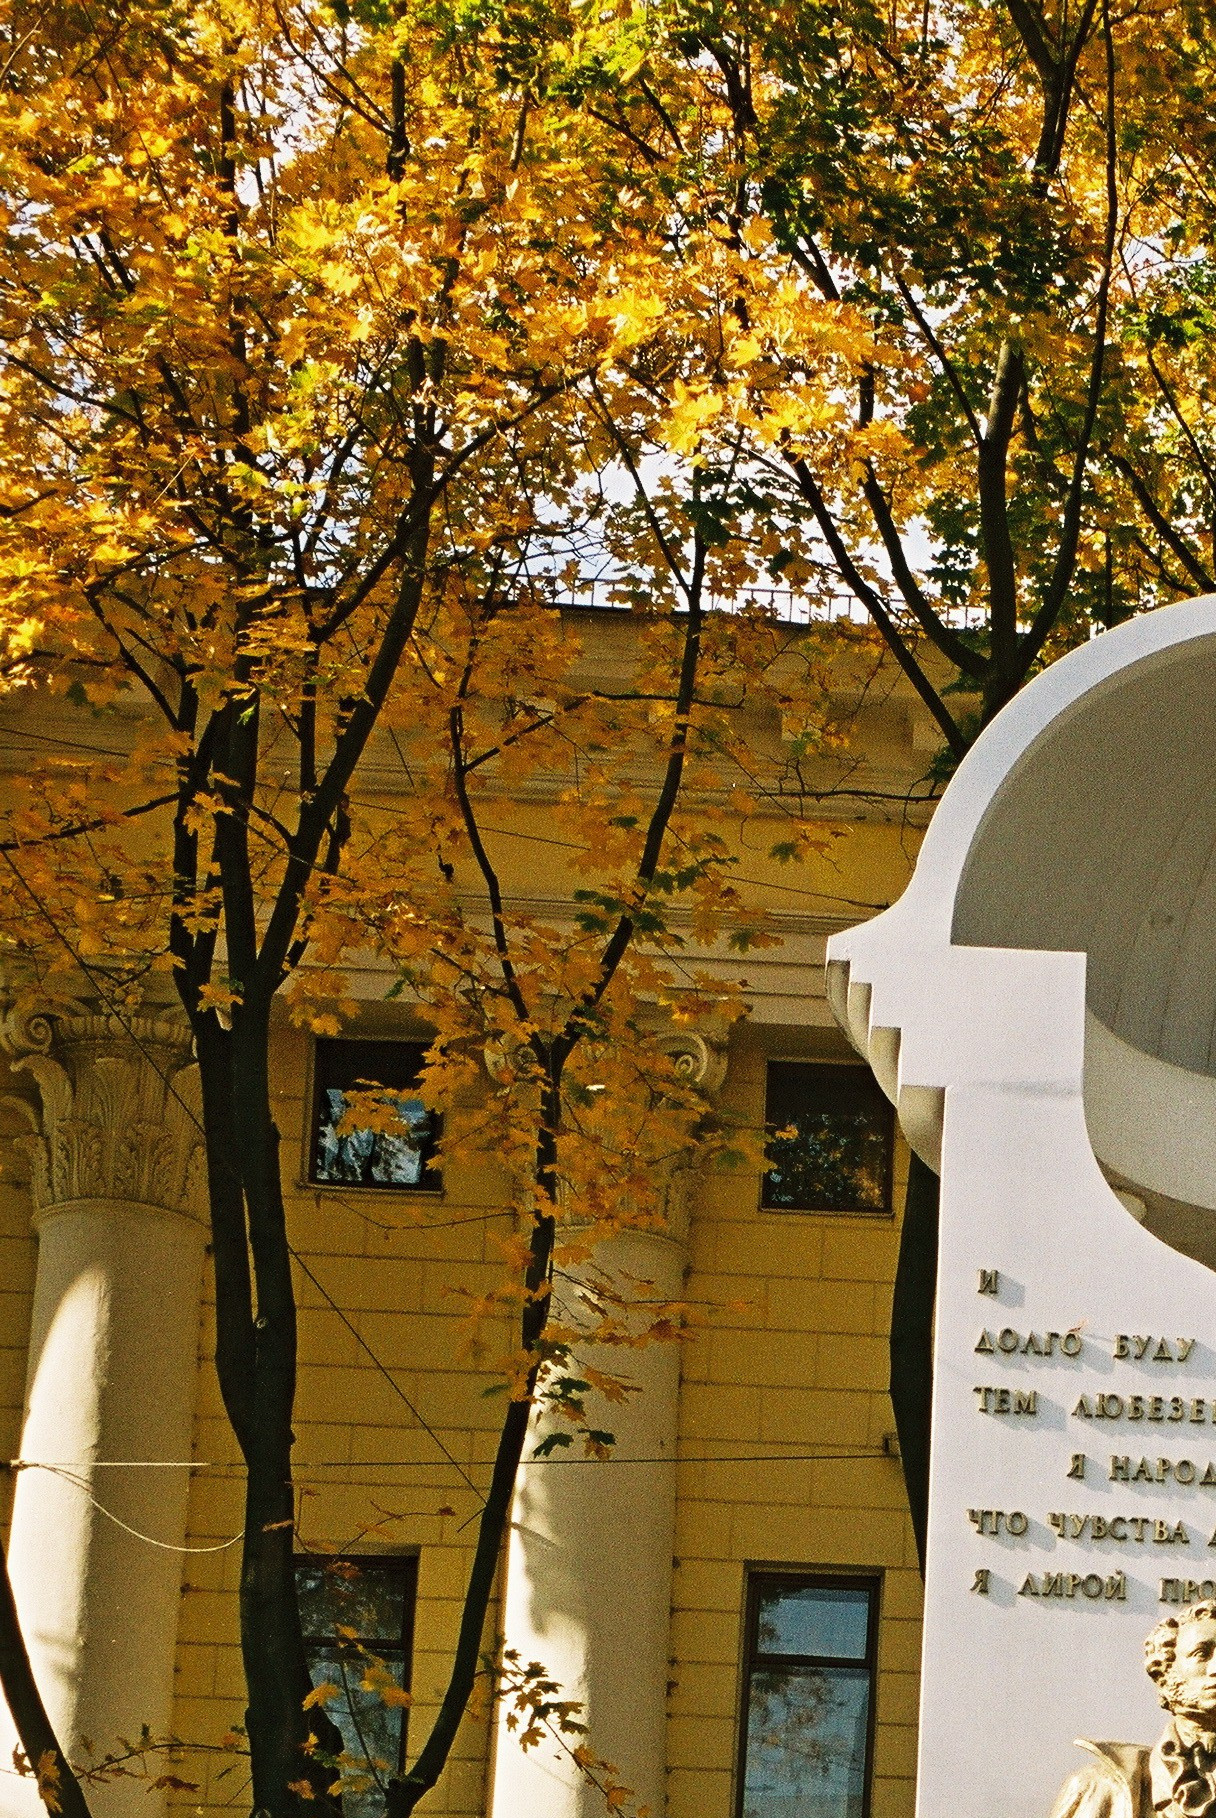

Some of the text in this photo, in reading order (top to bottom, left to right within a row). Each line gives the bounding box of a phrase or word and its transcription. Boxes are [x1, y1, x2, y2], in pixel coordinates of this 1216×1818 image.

[977, 1268, 999, 1294] И
[973, 1328, 1197, 1362] ДОЛГО БУДУ
[973, 1386, 1037, 1414] ТЕМ
[1066, 1453, 1086, 1478] Я
[966, 1508, 1028, 1535] ЧТО
[1048, 1512, 1190, 1543] ЧУВСТВА
[970, 1569, 991, 1594] Я
[1017, 1569, 1127, 1600] ЛИРОЙ
